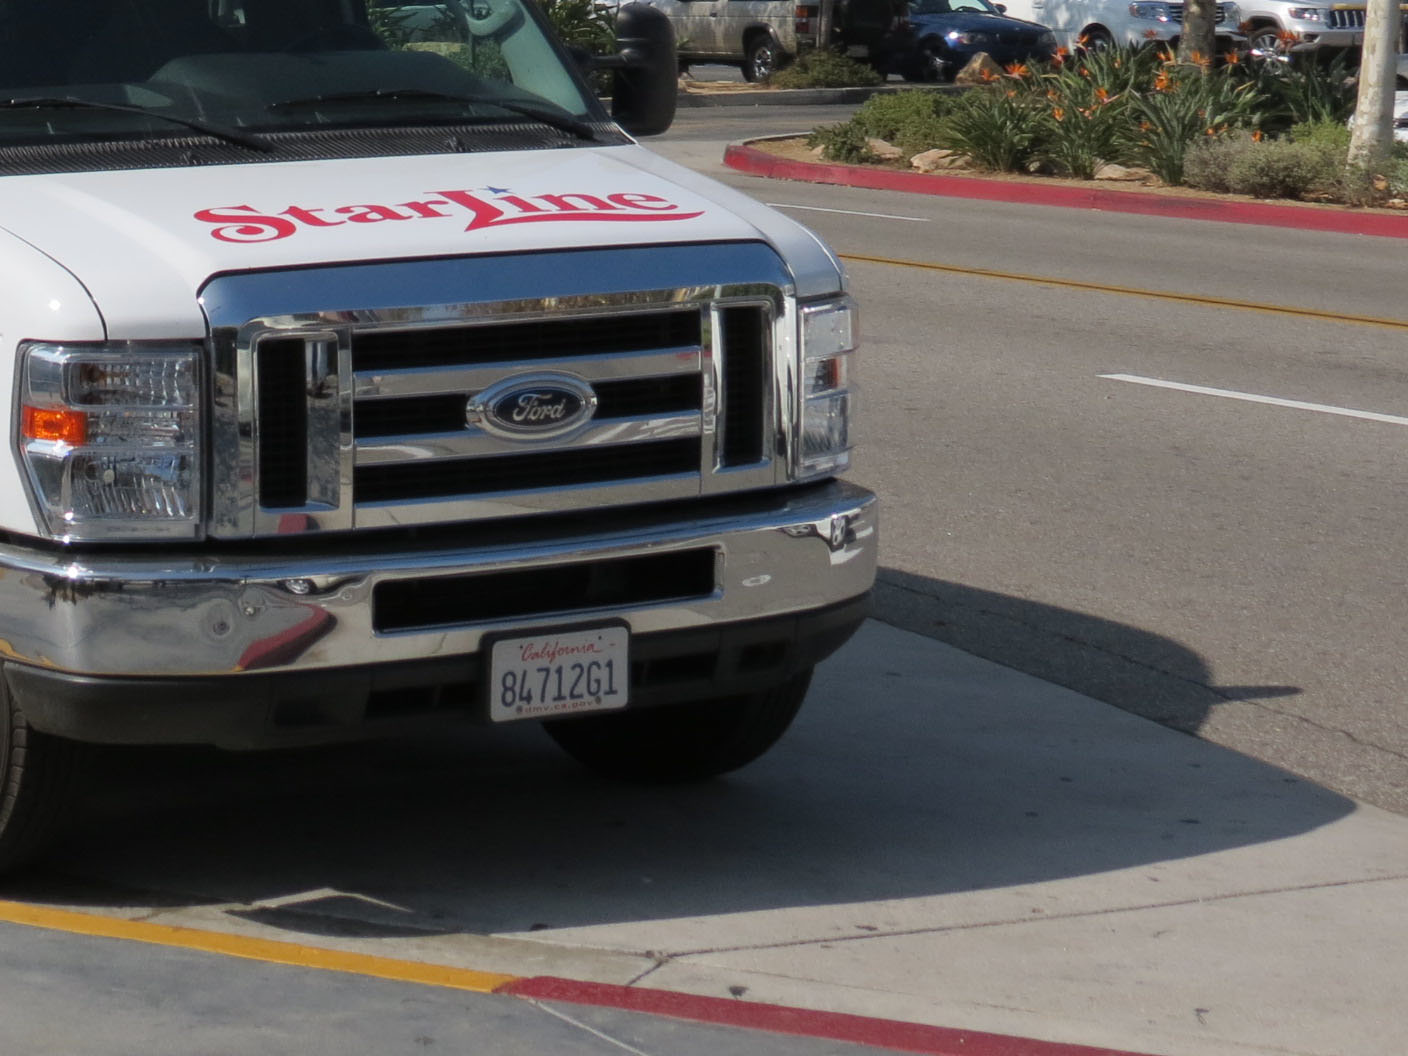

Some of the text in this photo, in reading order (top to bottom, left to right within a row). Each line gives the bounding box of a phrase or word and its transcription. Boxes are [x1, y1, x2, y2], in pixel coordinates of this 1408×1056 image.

[193, 185, 705, 244] StarLine
[513, 393, 566, 421] Ford
[521, 641, 603, 663] California
[501, 658, 618, 707] 84712G1
[524, 700, 593, 714] dmv.ca.gov
